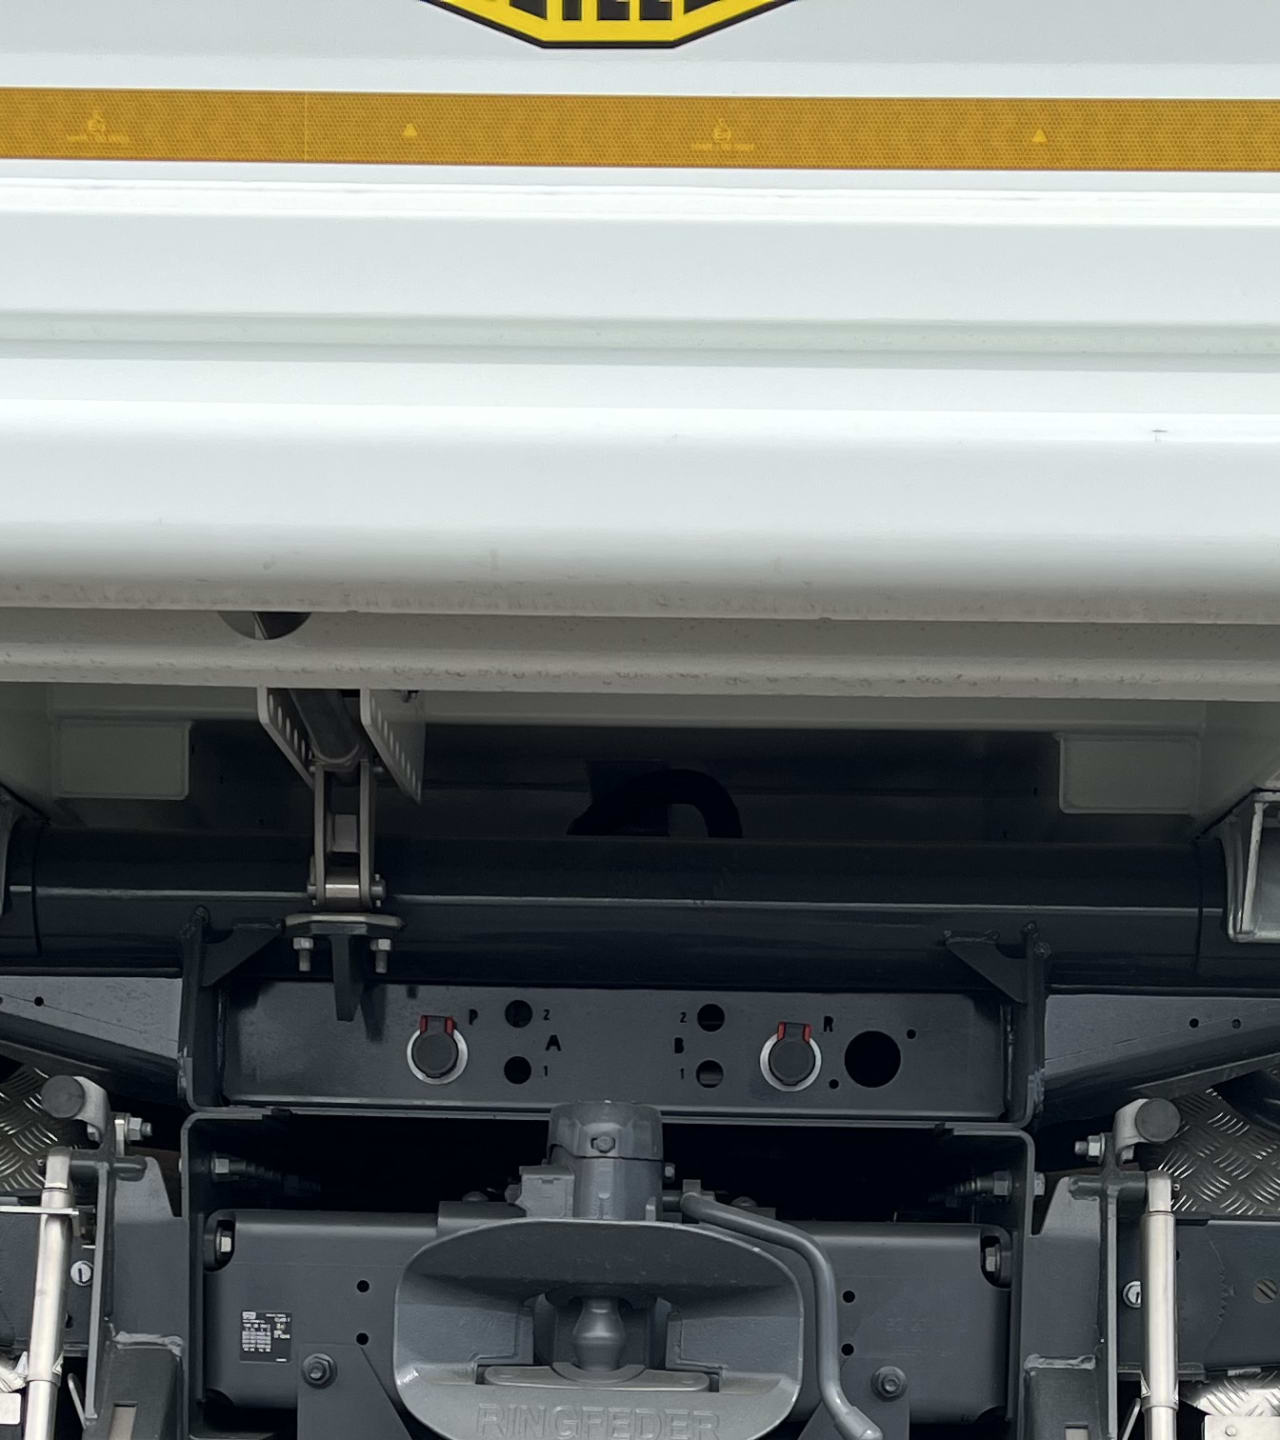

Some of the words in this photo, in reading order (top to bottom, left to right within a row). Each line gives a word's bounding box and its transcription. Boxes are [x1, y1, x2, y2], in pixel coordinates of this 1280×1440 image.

[468, 1008, 479, 1026] P
[543, 1009, 551, 1021] 2
[679, 1011, 688, 1024] 2
[823, 1015, 835, 1033] R
[545, 1034, 562, 1052] A
[674, 1037, 685, 1054] B
[543, 1065, 549, 1077] 1
[679, 1067, 685, 1080] 1
